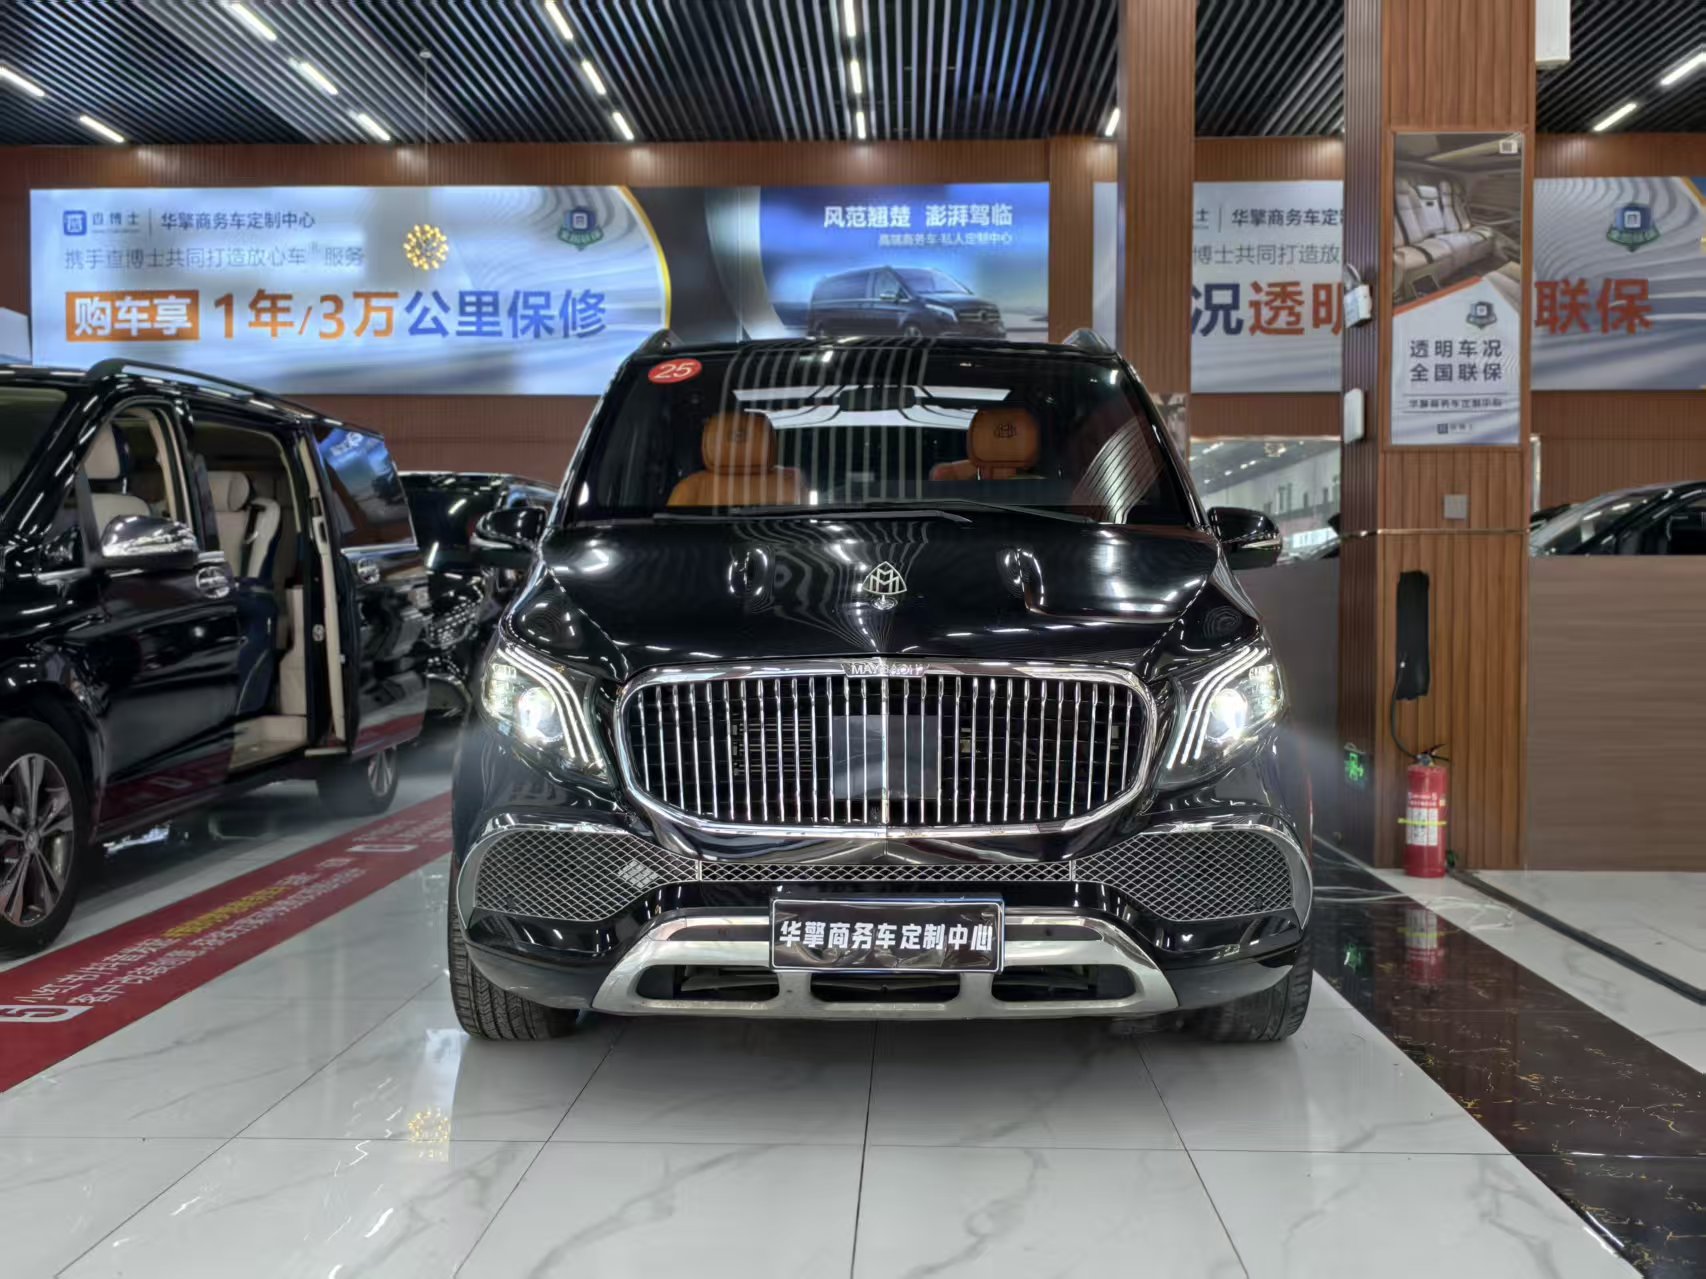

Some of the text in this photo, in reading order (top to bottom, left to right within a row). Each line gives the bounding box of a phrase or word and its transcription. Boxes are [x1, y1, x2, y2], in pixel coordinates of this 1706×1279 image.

[161, 211, 316, 230] 华擎商务车定制中心
[823, 203, 1013, 228] 风范翘楚 澎湃驾临
[1231, 209, 1343, 227] 华擎商务车定
[73, 295, 193, 336] 购车享
[1534, 277, 1654, 335] 联保
[1410, 340, 1502, 358] 透明车况
[654, 363, 695, 379] 25
[1410, 363, 1502, 382] 全国联保
[780, 920, 993, 951] 华擎商务车定制中心
